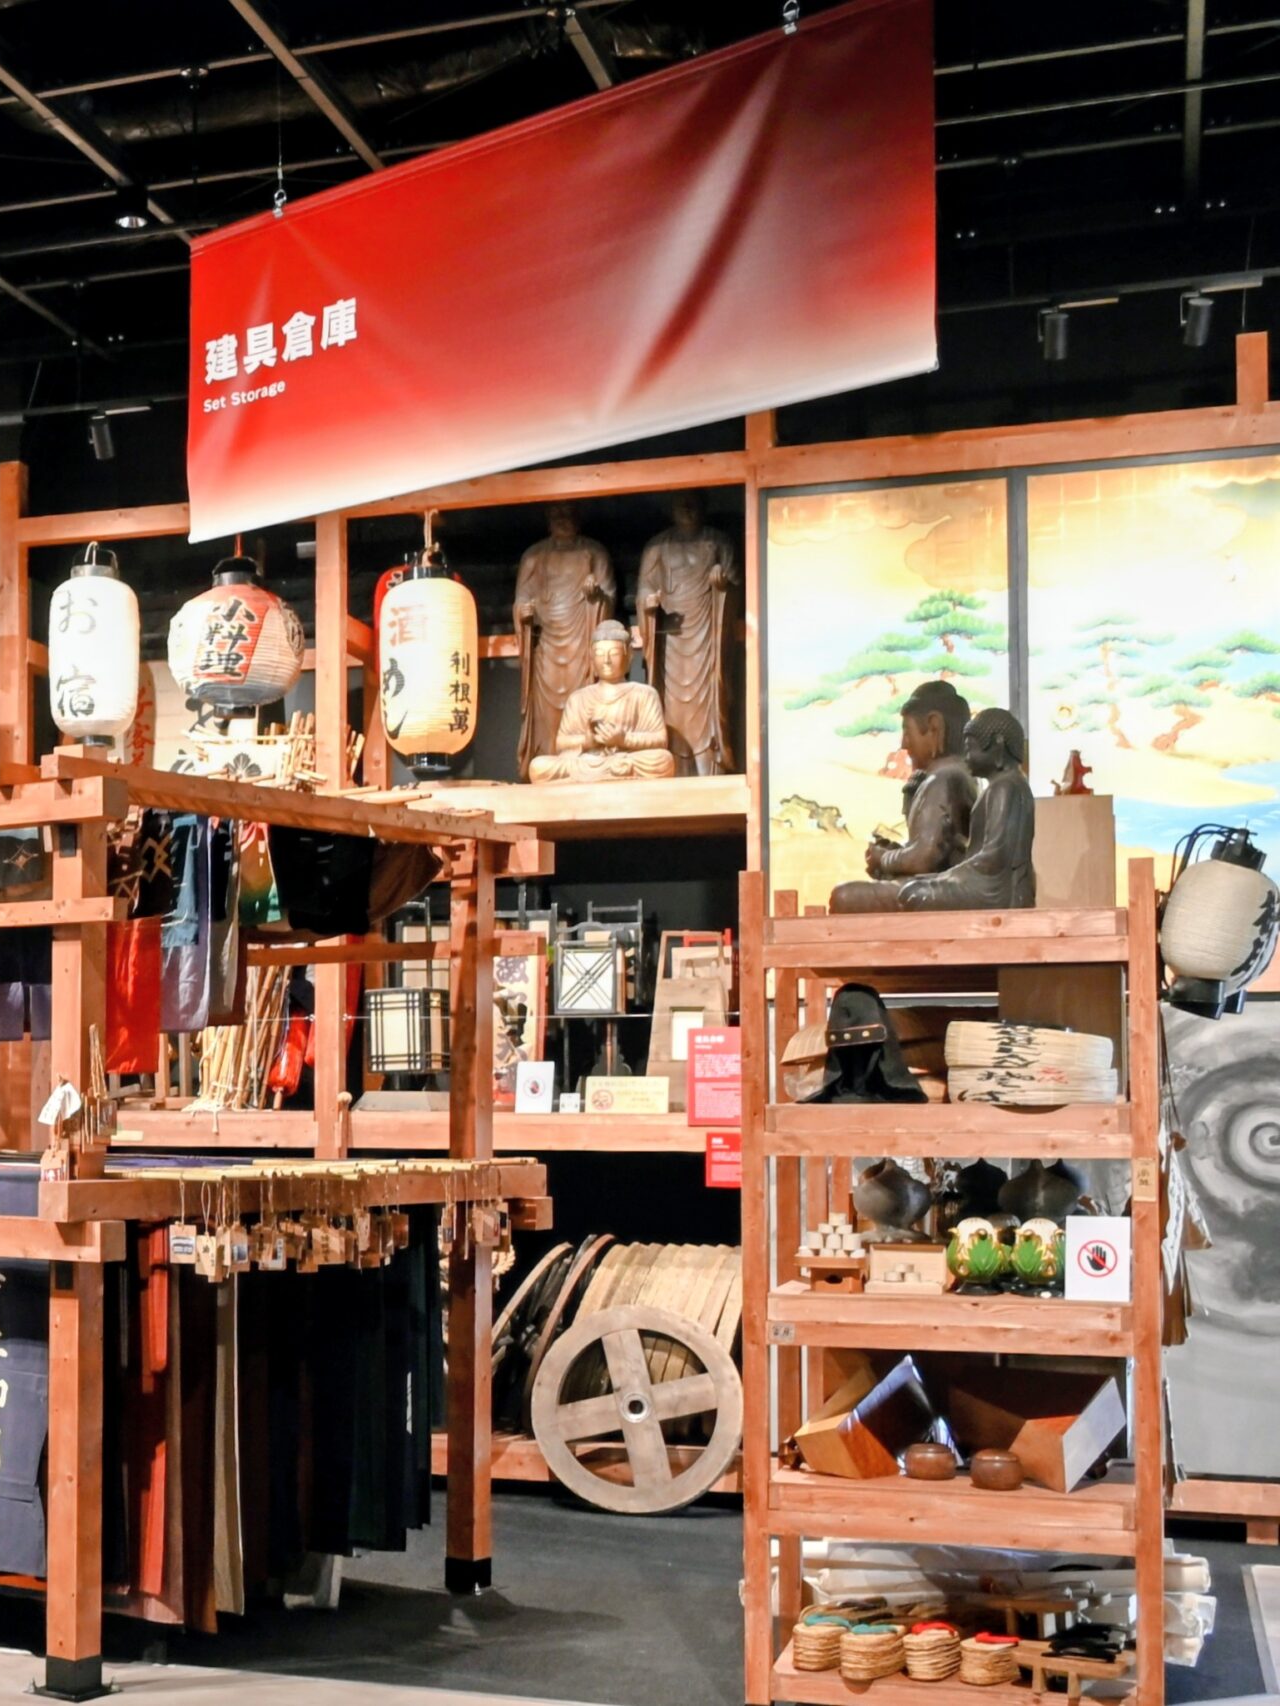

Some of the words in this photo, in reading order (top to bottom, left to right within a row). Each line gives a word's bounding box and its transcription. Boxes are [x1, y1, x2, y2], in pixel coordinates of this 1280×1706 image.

[204, 297, 357, 385] 建具倉庫
[203, 396, 227, 413] Set
[231, 380, 286, 407] Storage
[55, 589, 98, 716] お宿
[199, 598, 256, 678] 小料理
